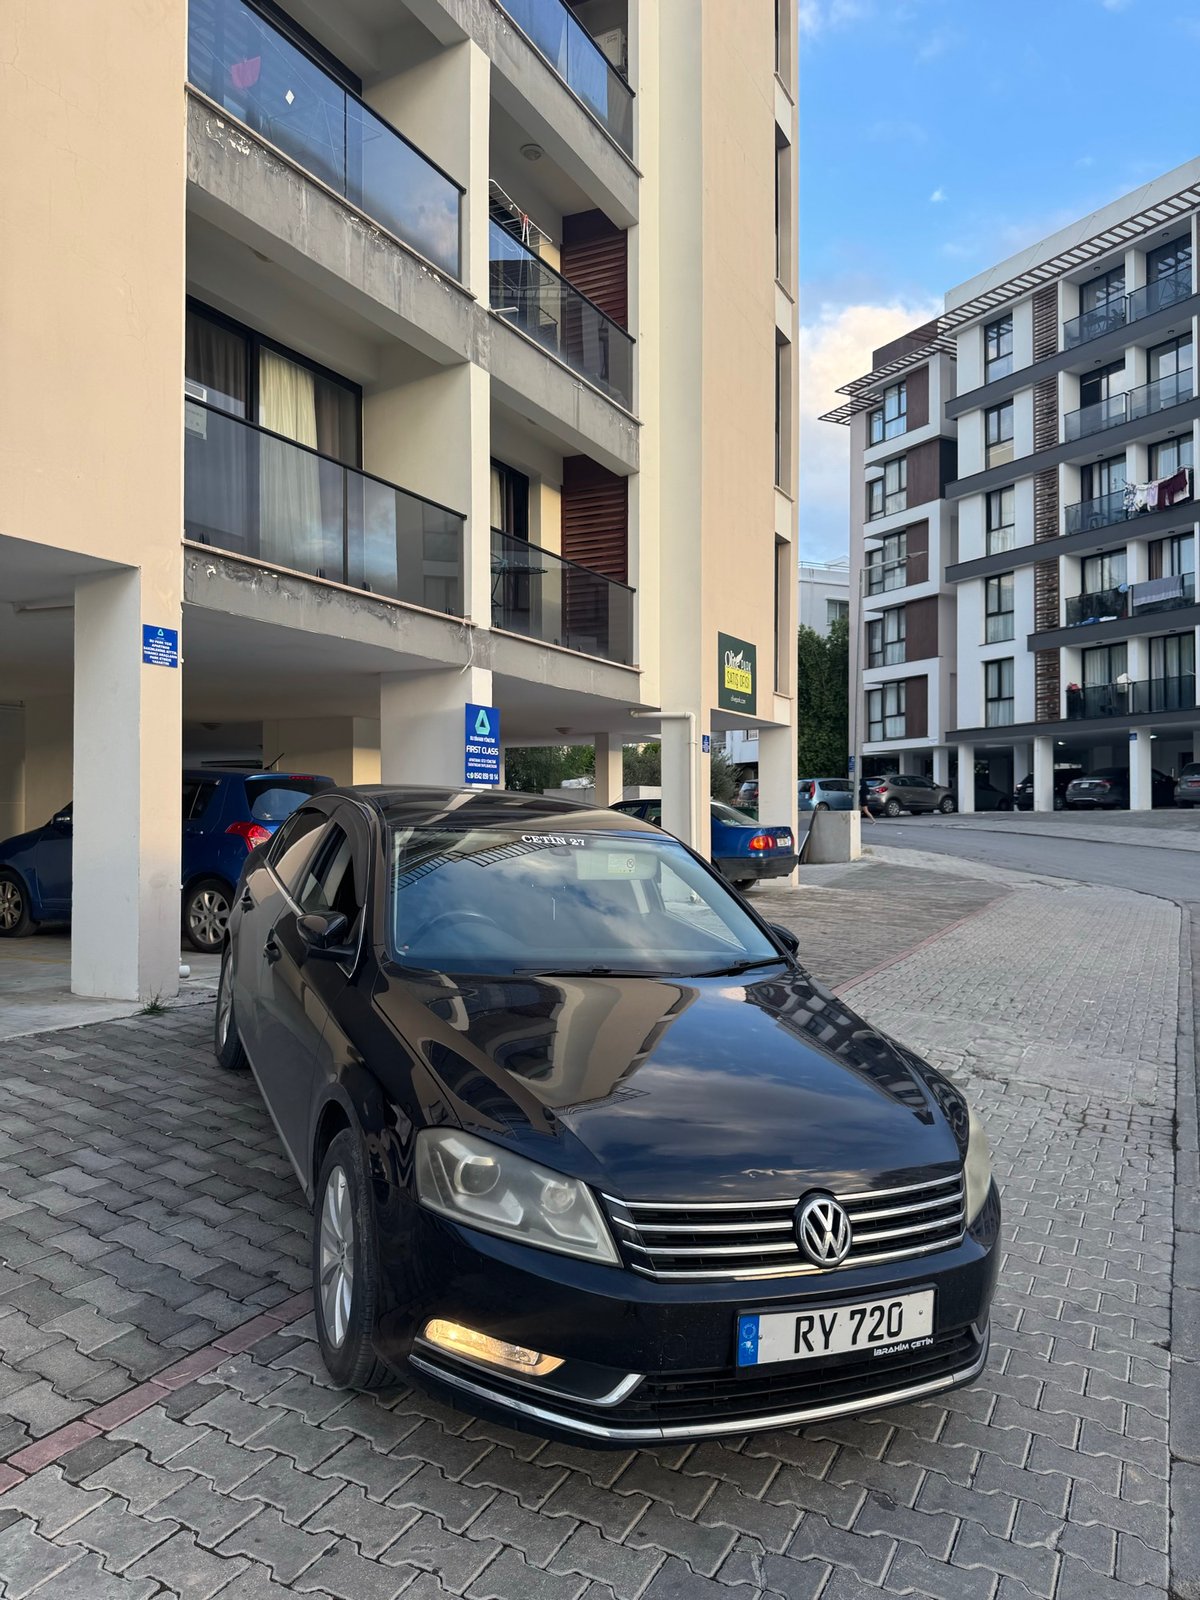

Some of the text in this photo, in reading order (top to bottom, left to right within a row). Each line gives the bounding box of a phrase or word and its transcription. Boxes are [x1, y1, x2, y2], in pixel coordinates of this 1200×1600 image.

[466, 745, 499, 755] FIRST CLASS
[569, 838, 585, 846] 27
[794, 1301, 903, 1354] RY 720
[873, 1337, 934, 1357] İBRAHİM ÇETİN
